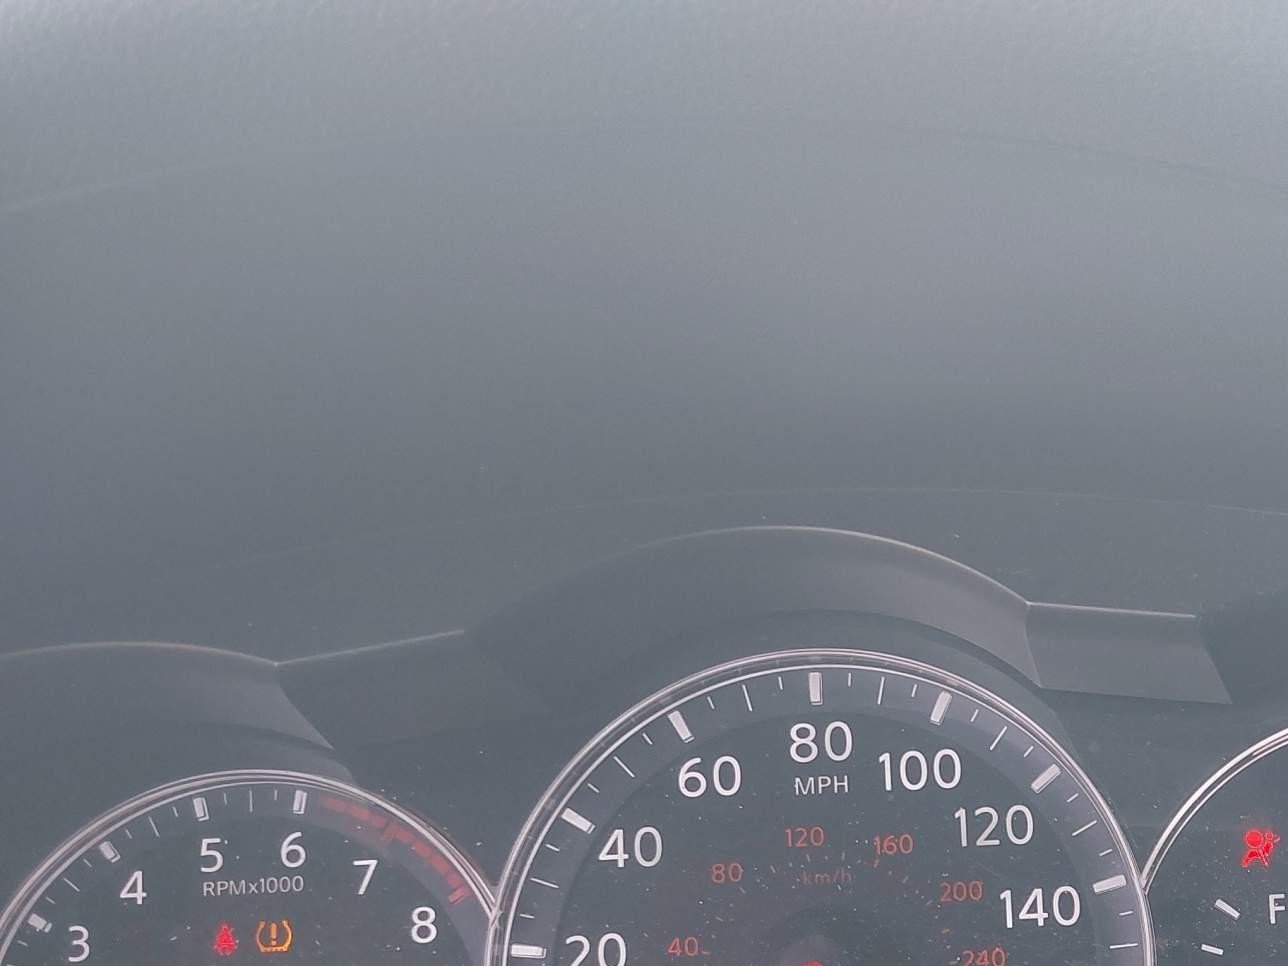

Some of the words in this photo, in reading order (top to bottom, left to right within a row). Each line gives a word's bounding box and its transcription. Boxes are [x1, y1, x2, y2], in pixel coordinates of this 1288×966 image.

[789, 722, 853, 762] 80
[677, 756, 742, 798] 60
[795, 776, 849, 795] MPH
[878, 749, 962, 791] 100
[784, 826, 825, 848] 120
[954, 804, 1035, 847] 120
[200, 838, 224, 873] 5
[280, 832, 306, 867] 6
[598, 826, 663, 868] 40
[873, 833, 914, 855] 160
[120, 871, 147, 905] 4
[353, 859, 378, 894] 7
[711, 863, 743, 883] 80
[940, 881, 983, 902] 200
[1000, 886, 1081, 928] 140
[1268, 894, 1286, 924] F
[411, 906, 437, 943] 8
[68, 926, 90, 963] 3
[667, 937, 699, 957] 40
